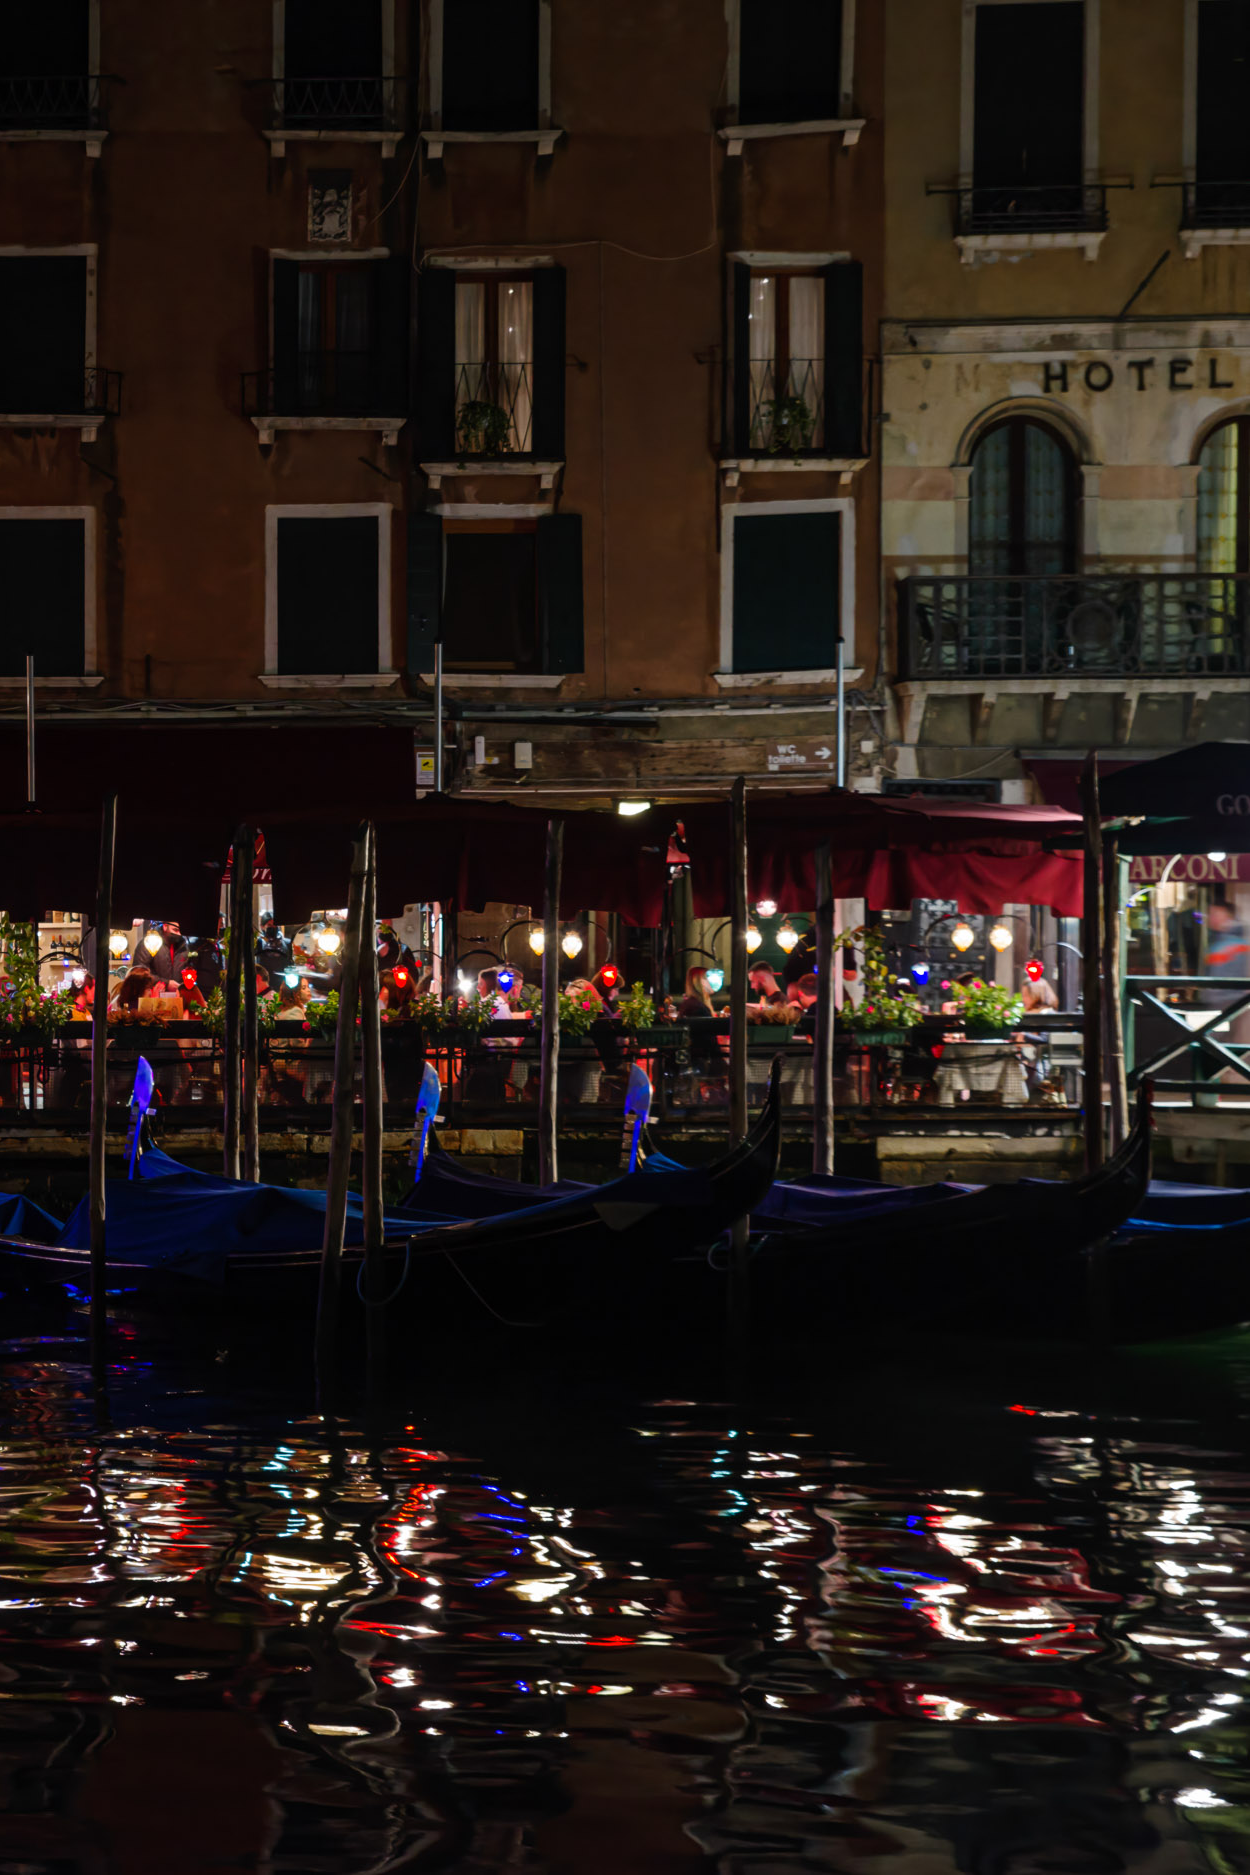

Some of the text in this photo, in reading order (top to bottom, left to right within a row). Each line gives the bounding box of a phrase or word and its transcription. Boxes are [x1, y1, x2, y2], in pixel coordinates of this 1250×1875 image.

[1043, 357, 1234, 393] HOTEL
[776, 744, 798, 754] WC
[1130, 854, 1240, 880] ARCONI
